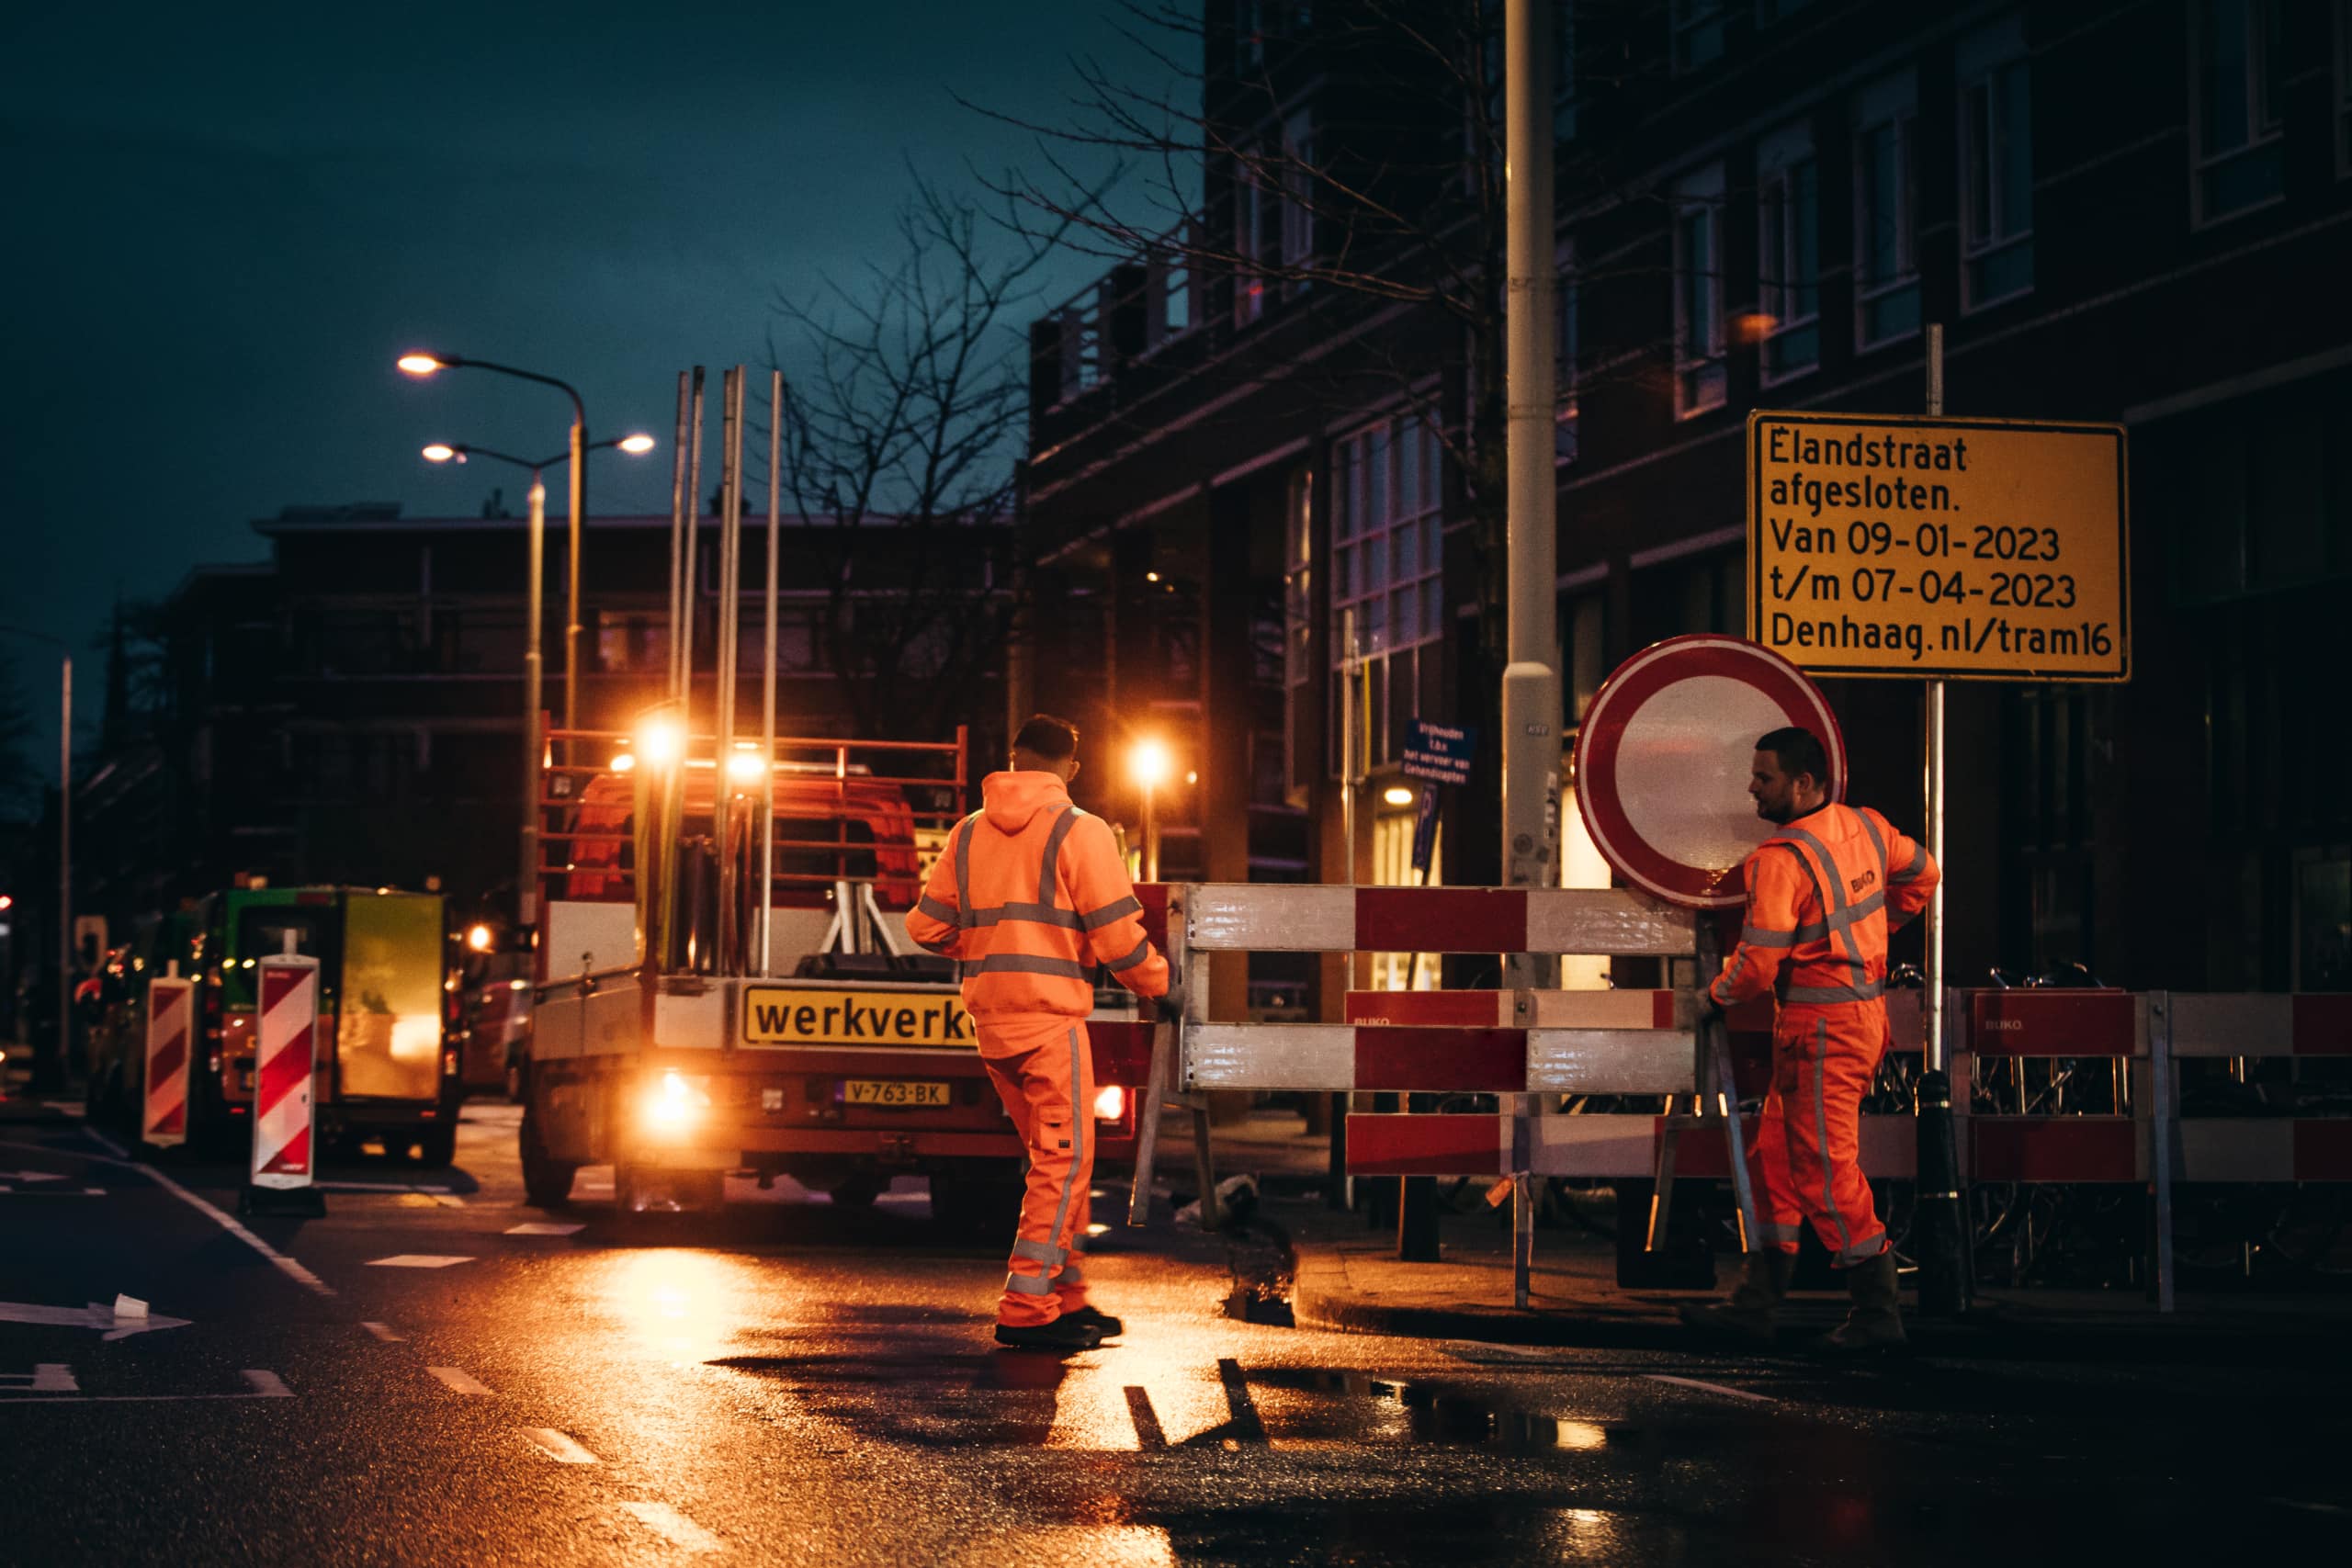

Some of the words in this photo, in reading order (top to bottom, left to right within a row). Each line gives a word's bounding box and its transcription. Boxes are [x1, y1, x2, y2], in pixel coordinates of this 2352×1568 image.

[1770, 425, 1967, 471] Elandstraat
[1770, 472, 1961, 517] afgesloten.
[1770, 518, 1836, 553] Van
[1848, 521, 2060, 561] 09-01-2023
[1770, 565, 1839, 601] t/m
[1852, 568, 2076, 609] 07-04-2023
[1771, 612, 2112, 661] Denhaag.nl/tram16
[755, 998, 976, 1040] werkverk
[852, 1083, 941, 1103] V-763-BK
